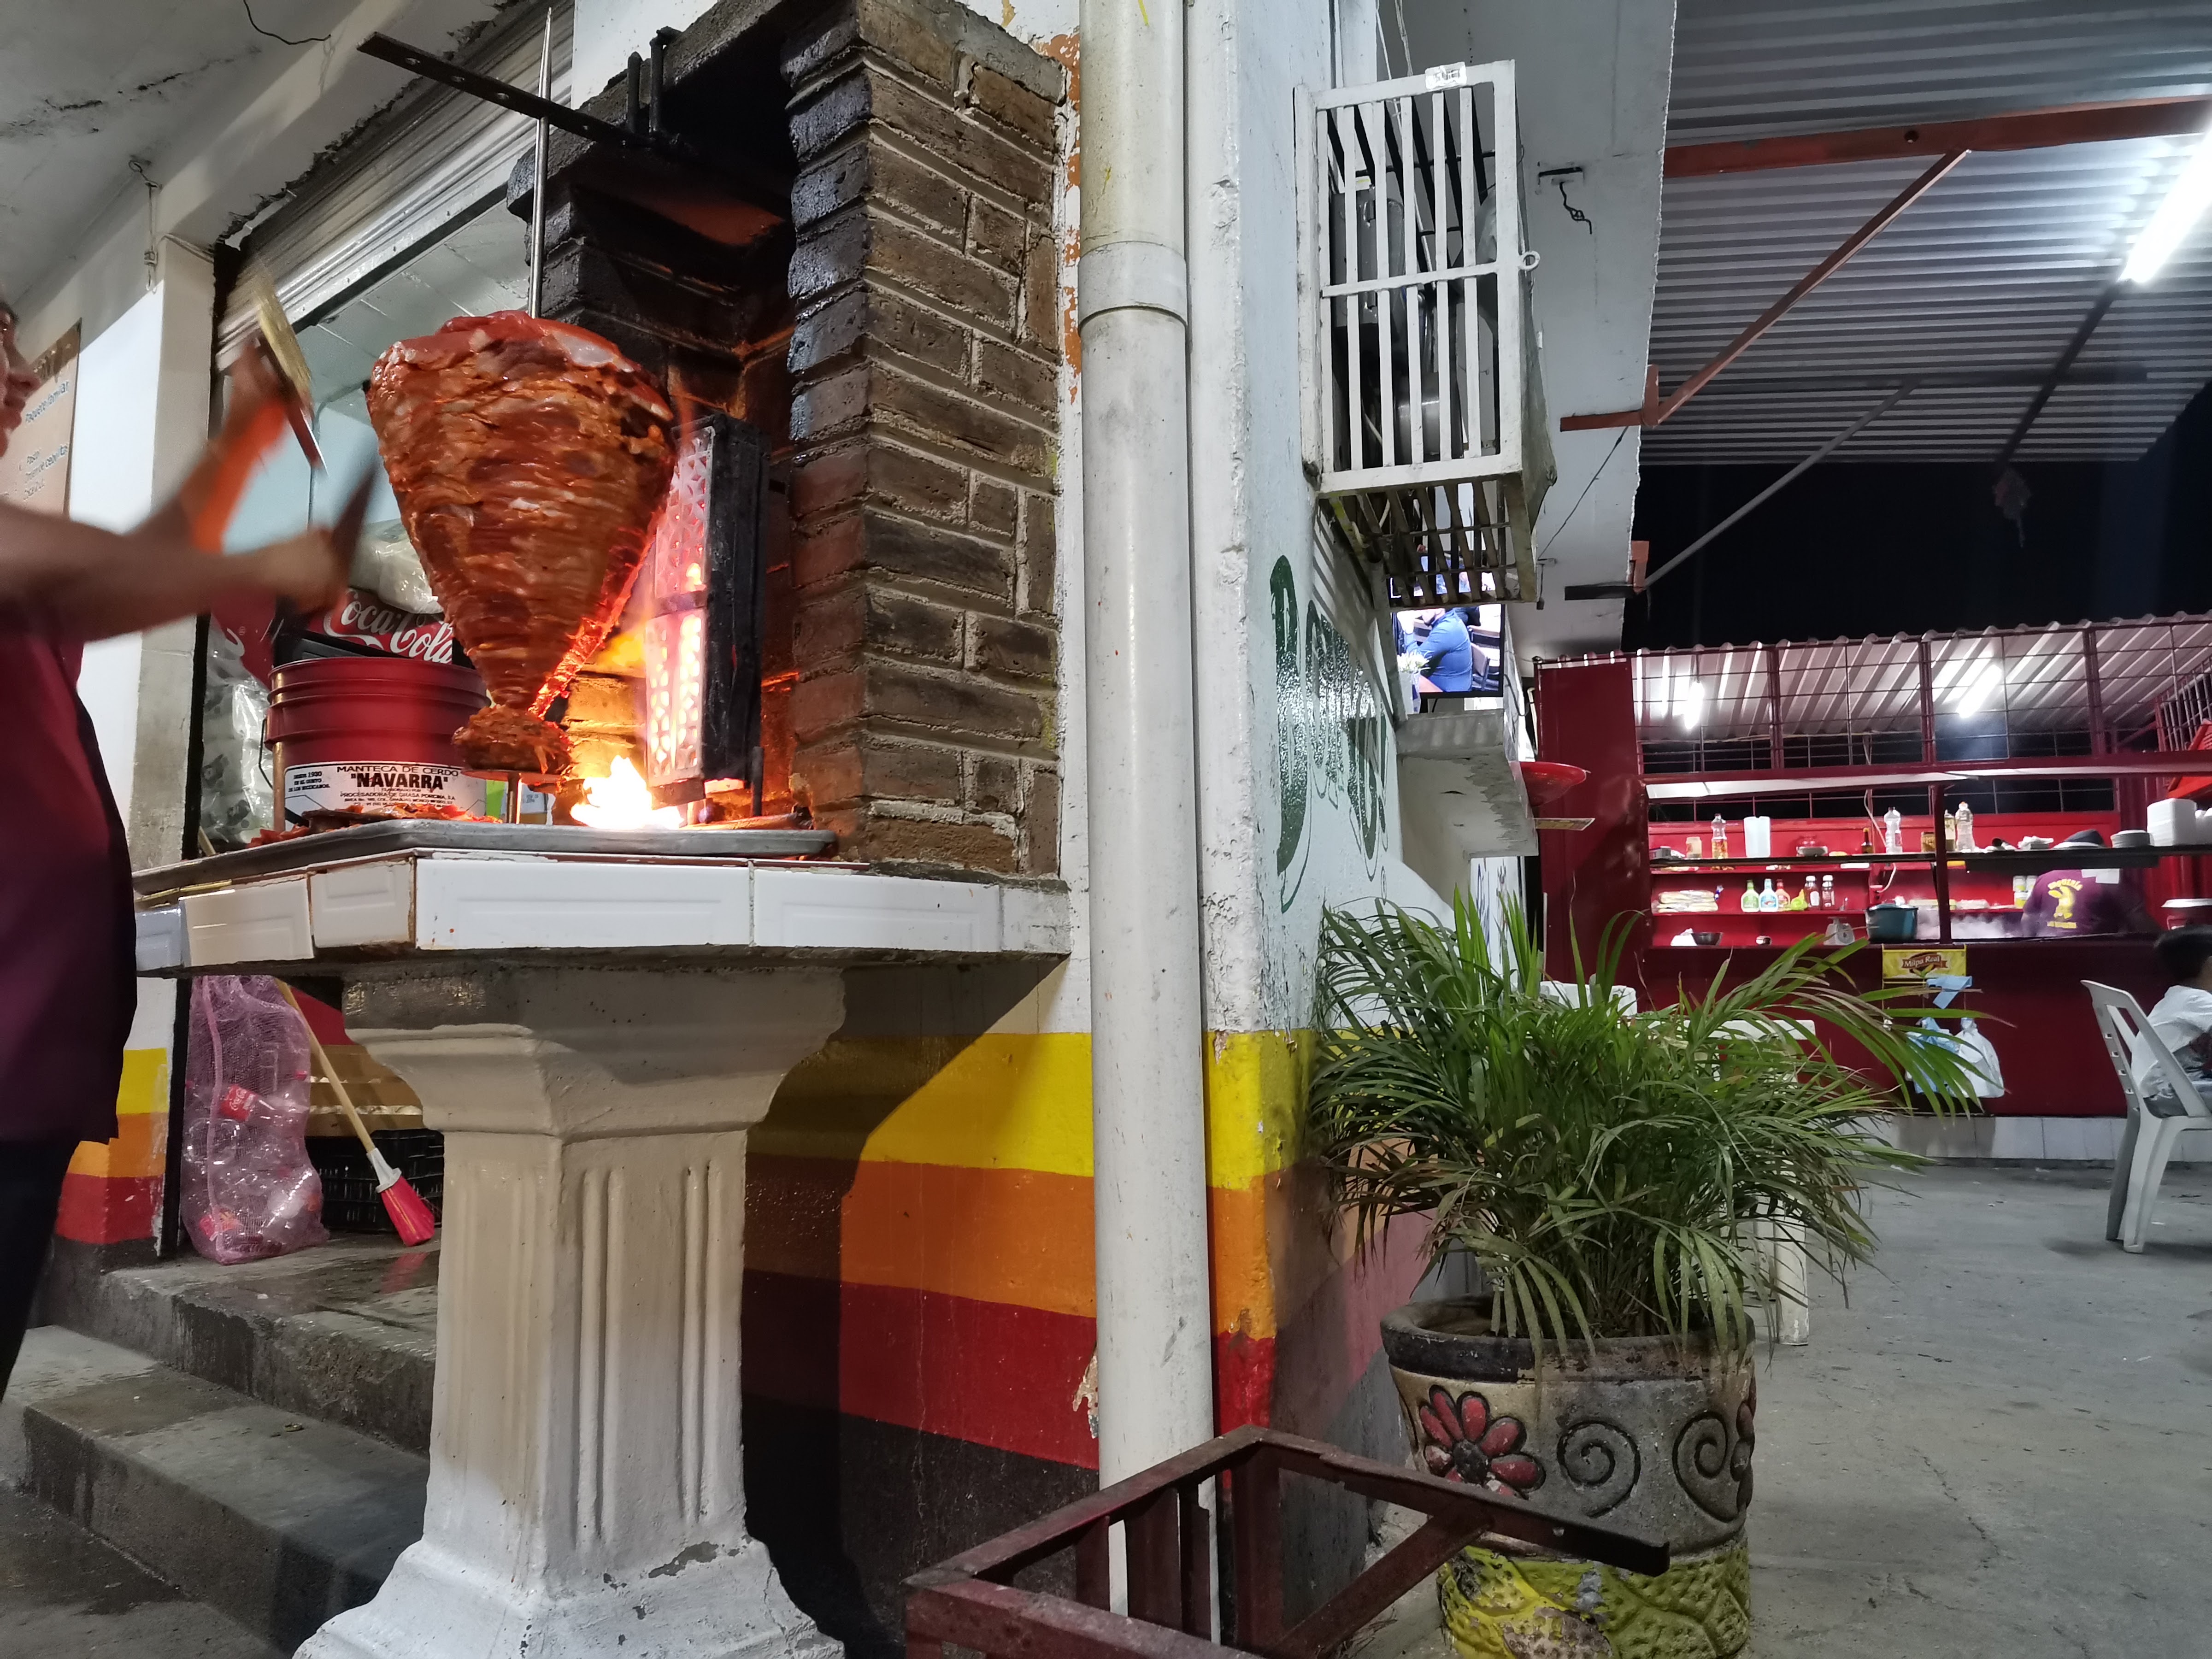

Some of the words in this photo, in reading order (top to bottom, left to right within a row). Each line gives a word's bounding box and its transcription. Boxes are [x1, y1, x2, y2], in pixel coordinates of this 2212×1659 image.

[423, 767, 459, 777] CERDO
[351, 773, 448, 790] "NAVARRA"
[1904, 959, 1924, 967] Milpa
